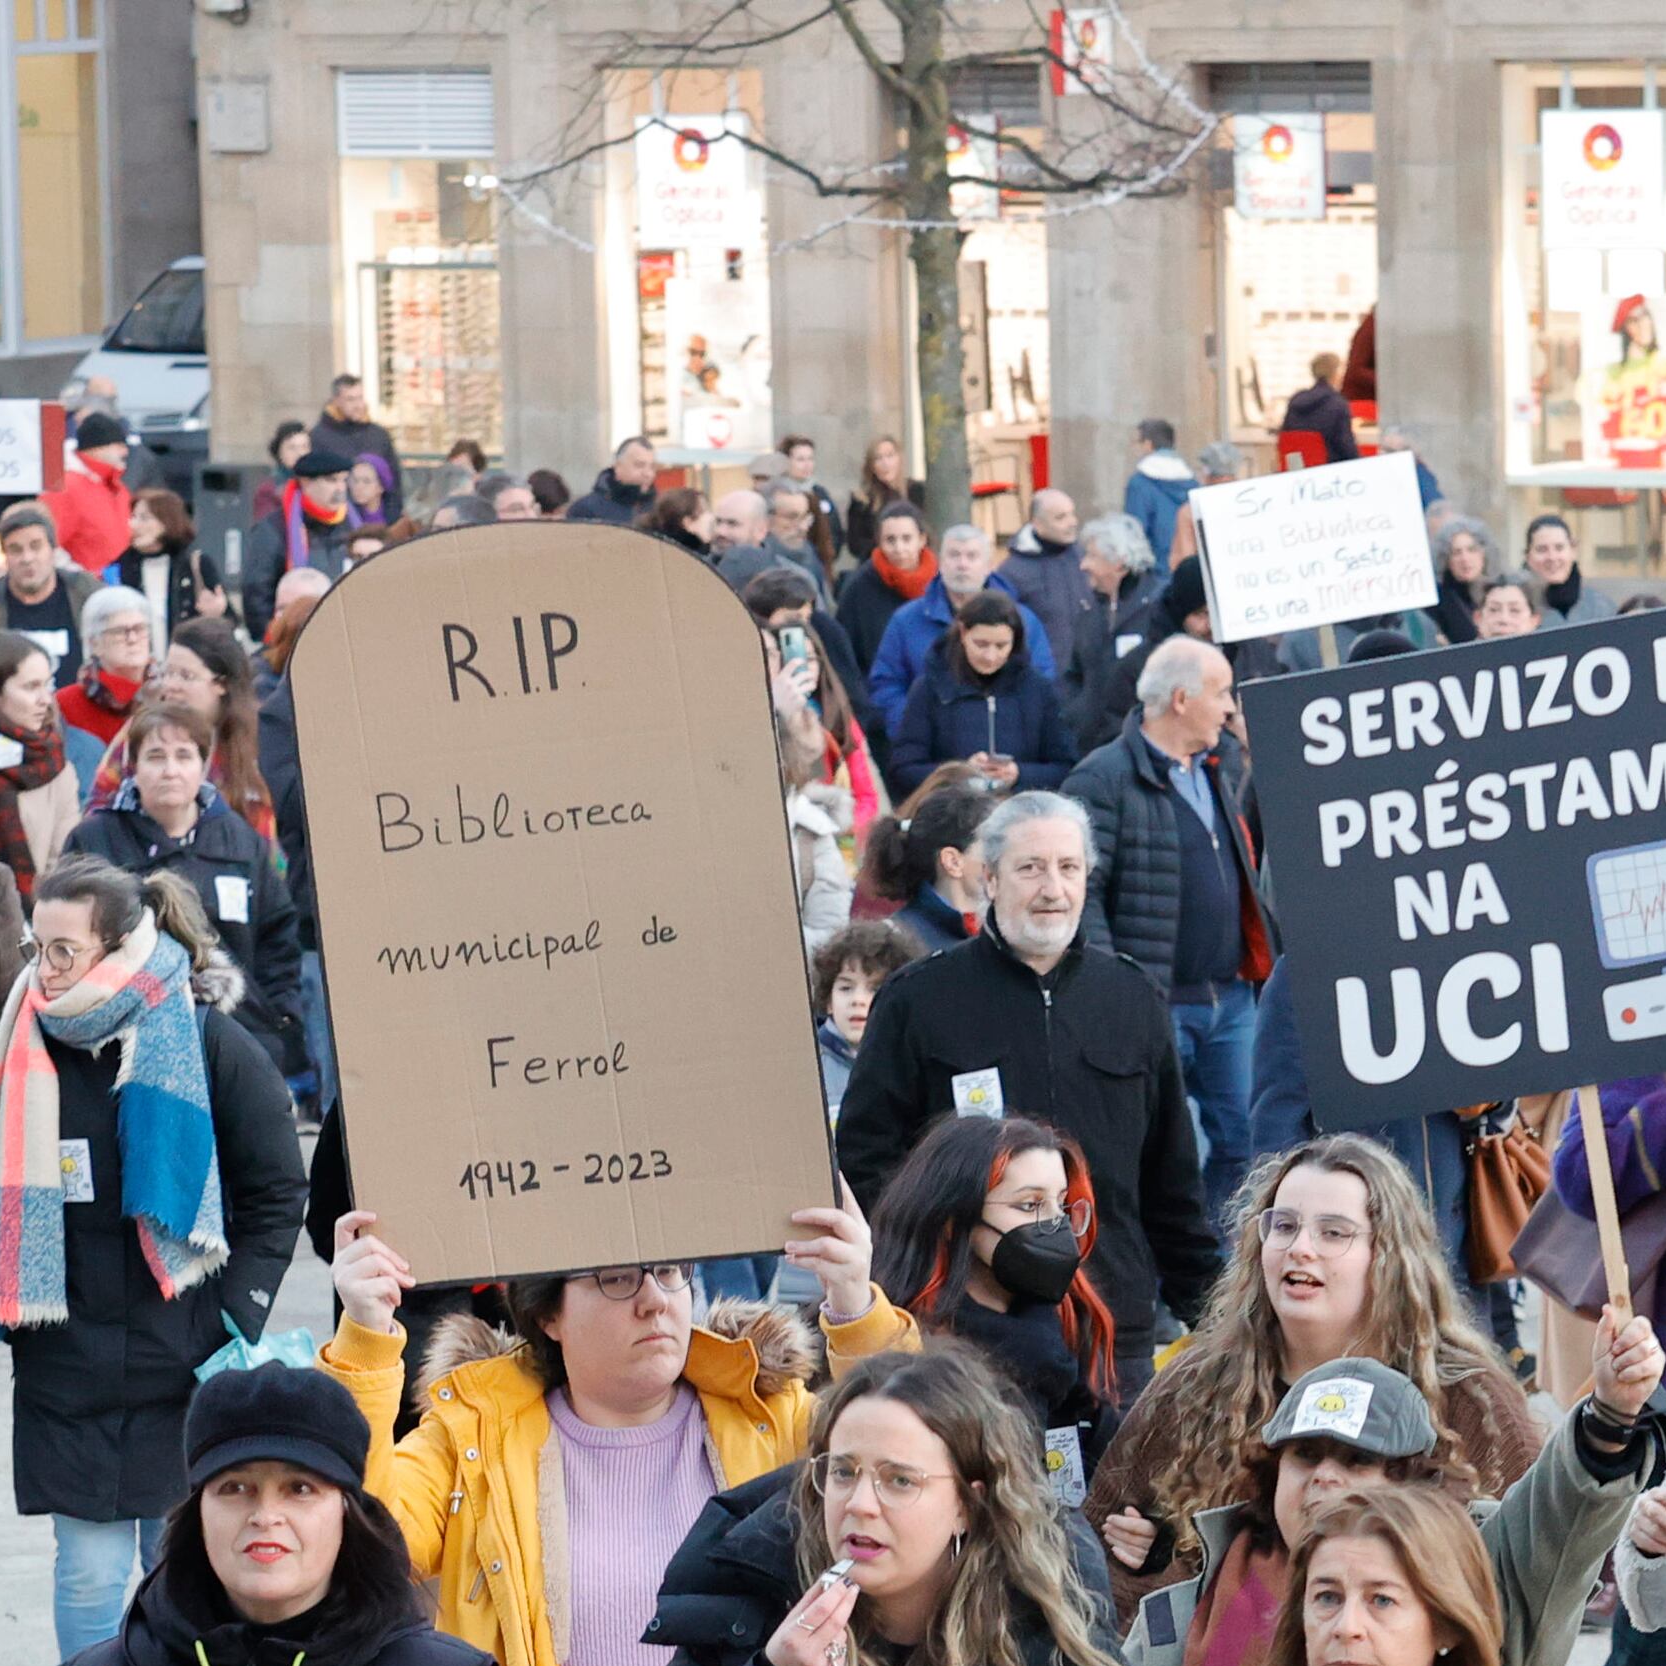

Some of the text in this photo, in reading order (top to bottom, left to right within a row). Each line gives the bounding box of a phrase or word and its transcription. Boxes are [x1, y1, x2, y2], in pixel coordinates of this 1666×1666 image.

[1234, 477, 1367, 518] Sr Mato
[1279, 513, 1396, 548] Biblioteca
[1235, 571, 1260, 589] no
[1266, 567, 1291, 584] es
[1298, 559, 1325, 580] un
[1244, 604, 1270, 624] es
[1276, 599, 1310, 619] una
[1299, 646, 1633, 767] SERVIZO
[375, 784, 654, 854] Biblioteca
[1392, 861, 1511, 942] NA
[377, 915, 680, 977] municipal de
[1334, 941, 1572, 1085] UCI
[485, 1035, 631, 1090] Ferrol
